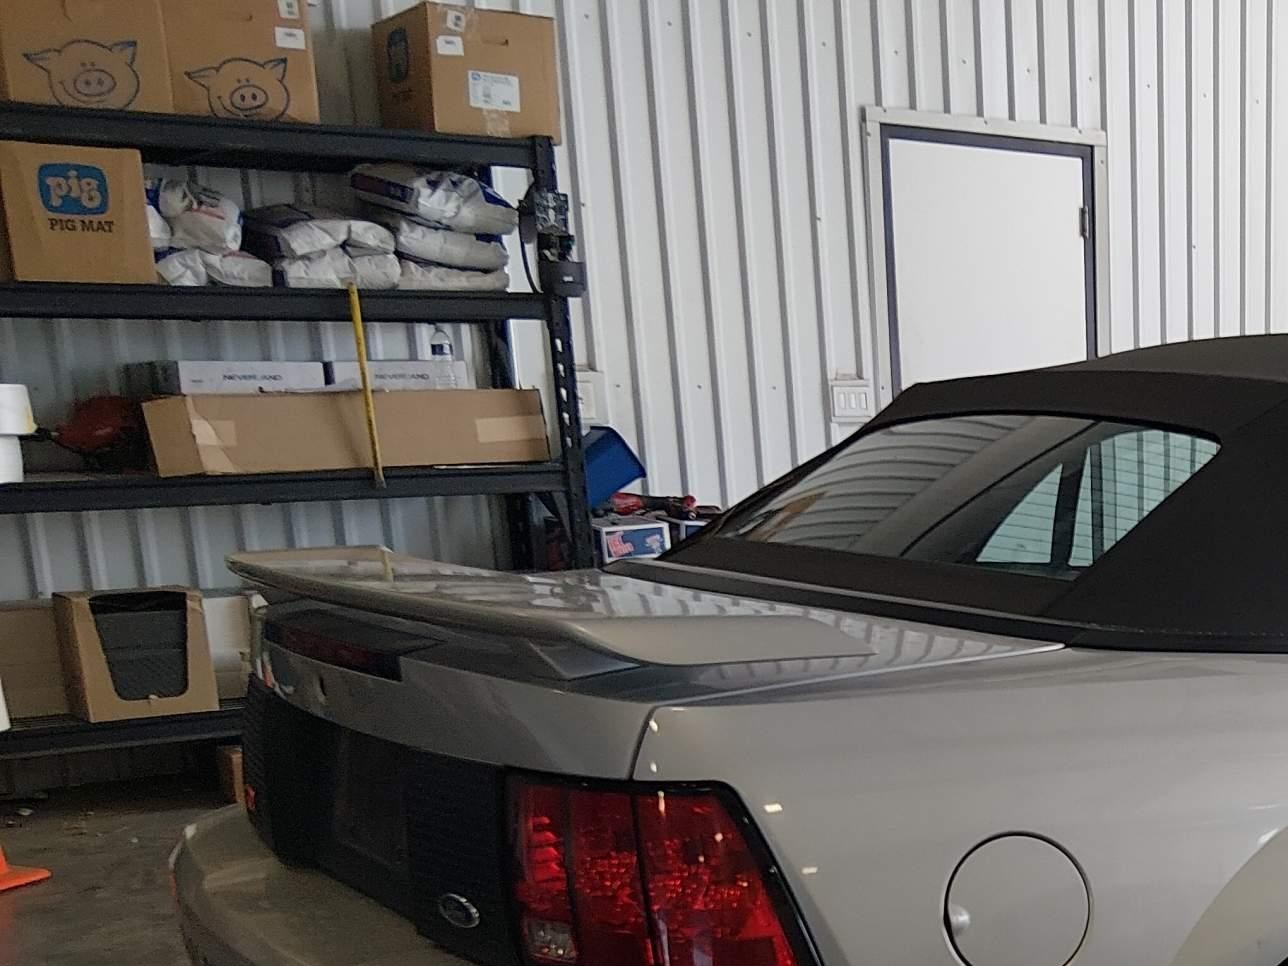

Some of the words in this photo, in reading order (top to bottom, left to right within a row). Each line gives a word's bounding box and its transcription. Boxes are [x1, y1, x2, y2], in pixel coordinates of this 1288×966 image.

[46, 170, 102, 208] pig
[48, 217, 76, 232] PIG
[80, 219, 114, 233] MAT
